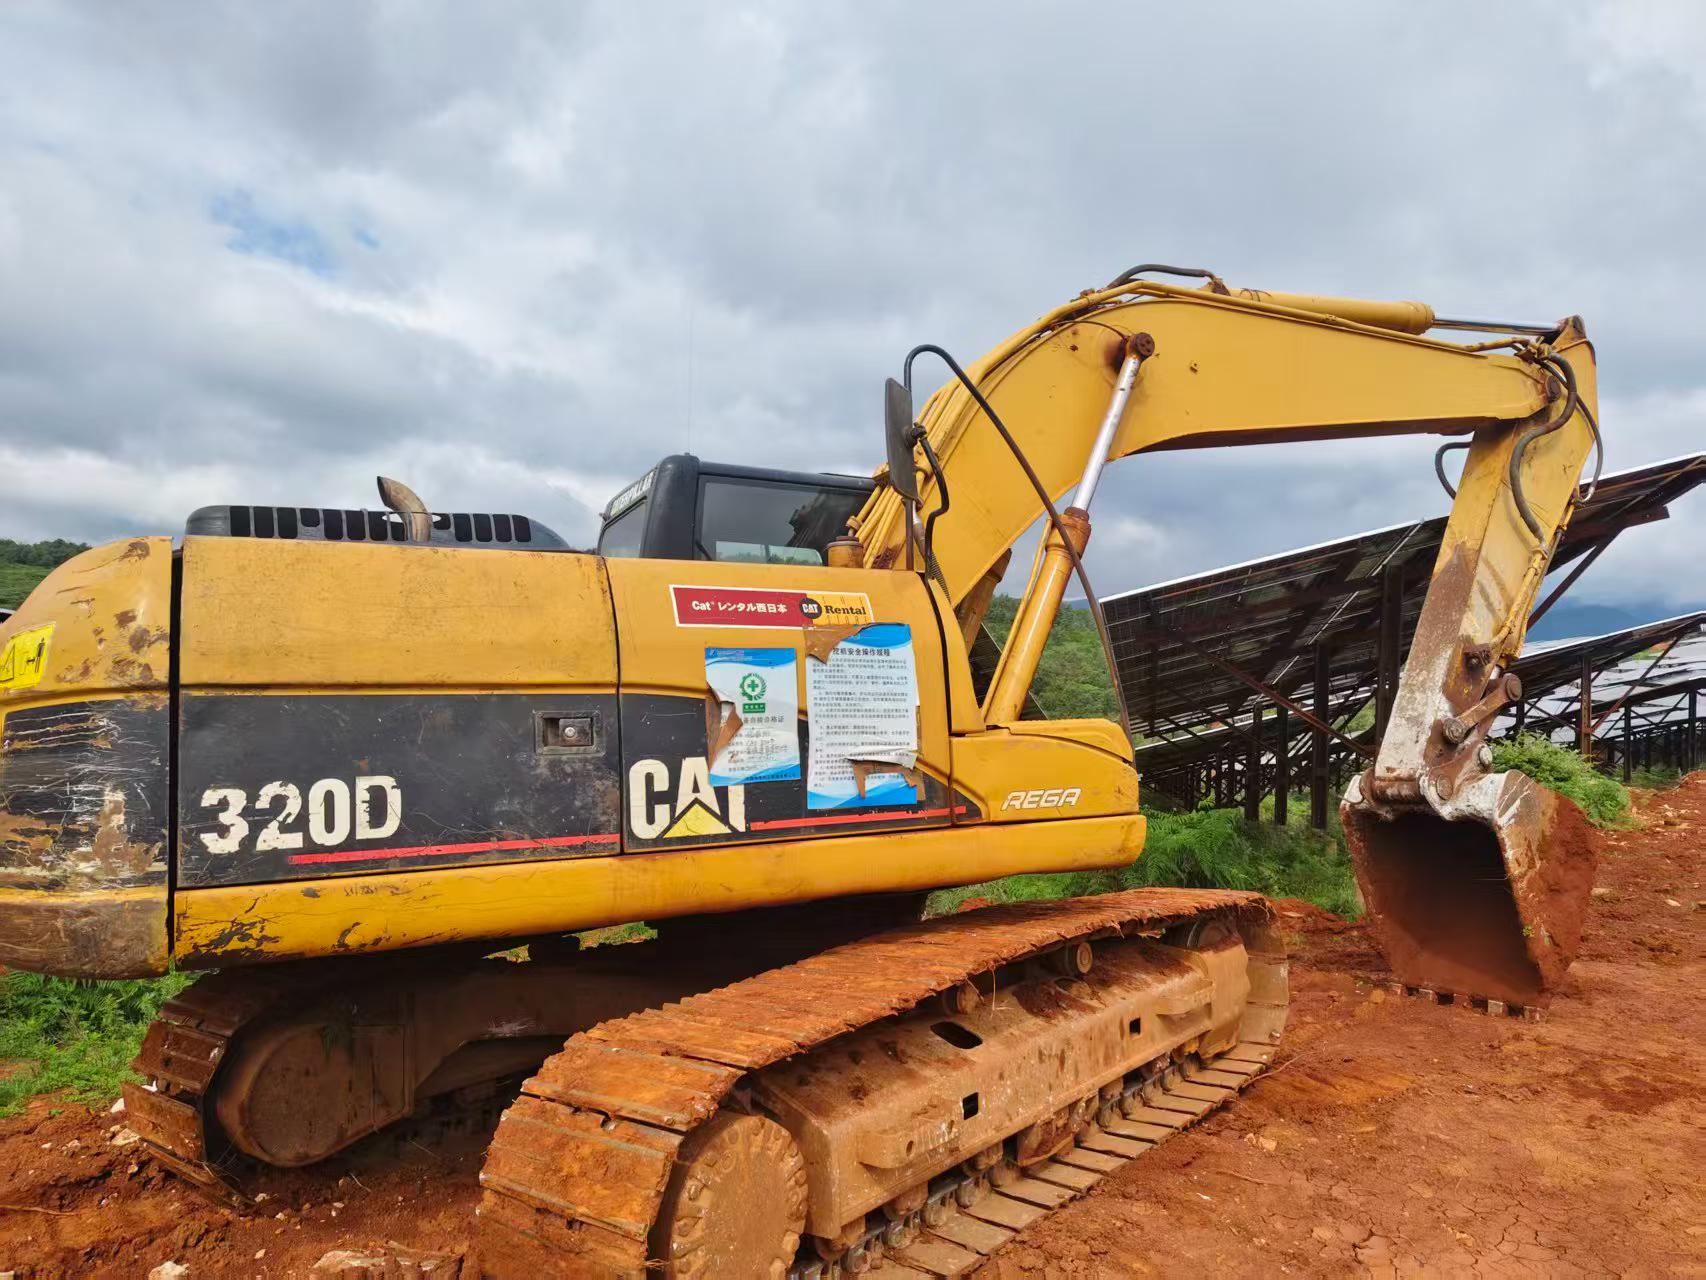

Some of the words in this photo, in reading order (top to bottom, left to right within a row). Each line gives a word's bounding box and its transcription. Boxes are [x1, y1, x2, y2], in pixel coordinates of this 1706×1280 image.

[718, 601, 787, 613] レンタル西日本
[824, 605, 867, 615] Rental
[1000, 788, 1082, 811] REGA
[199, 775, 402, 854] 320D
